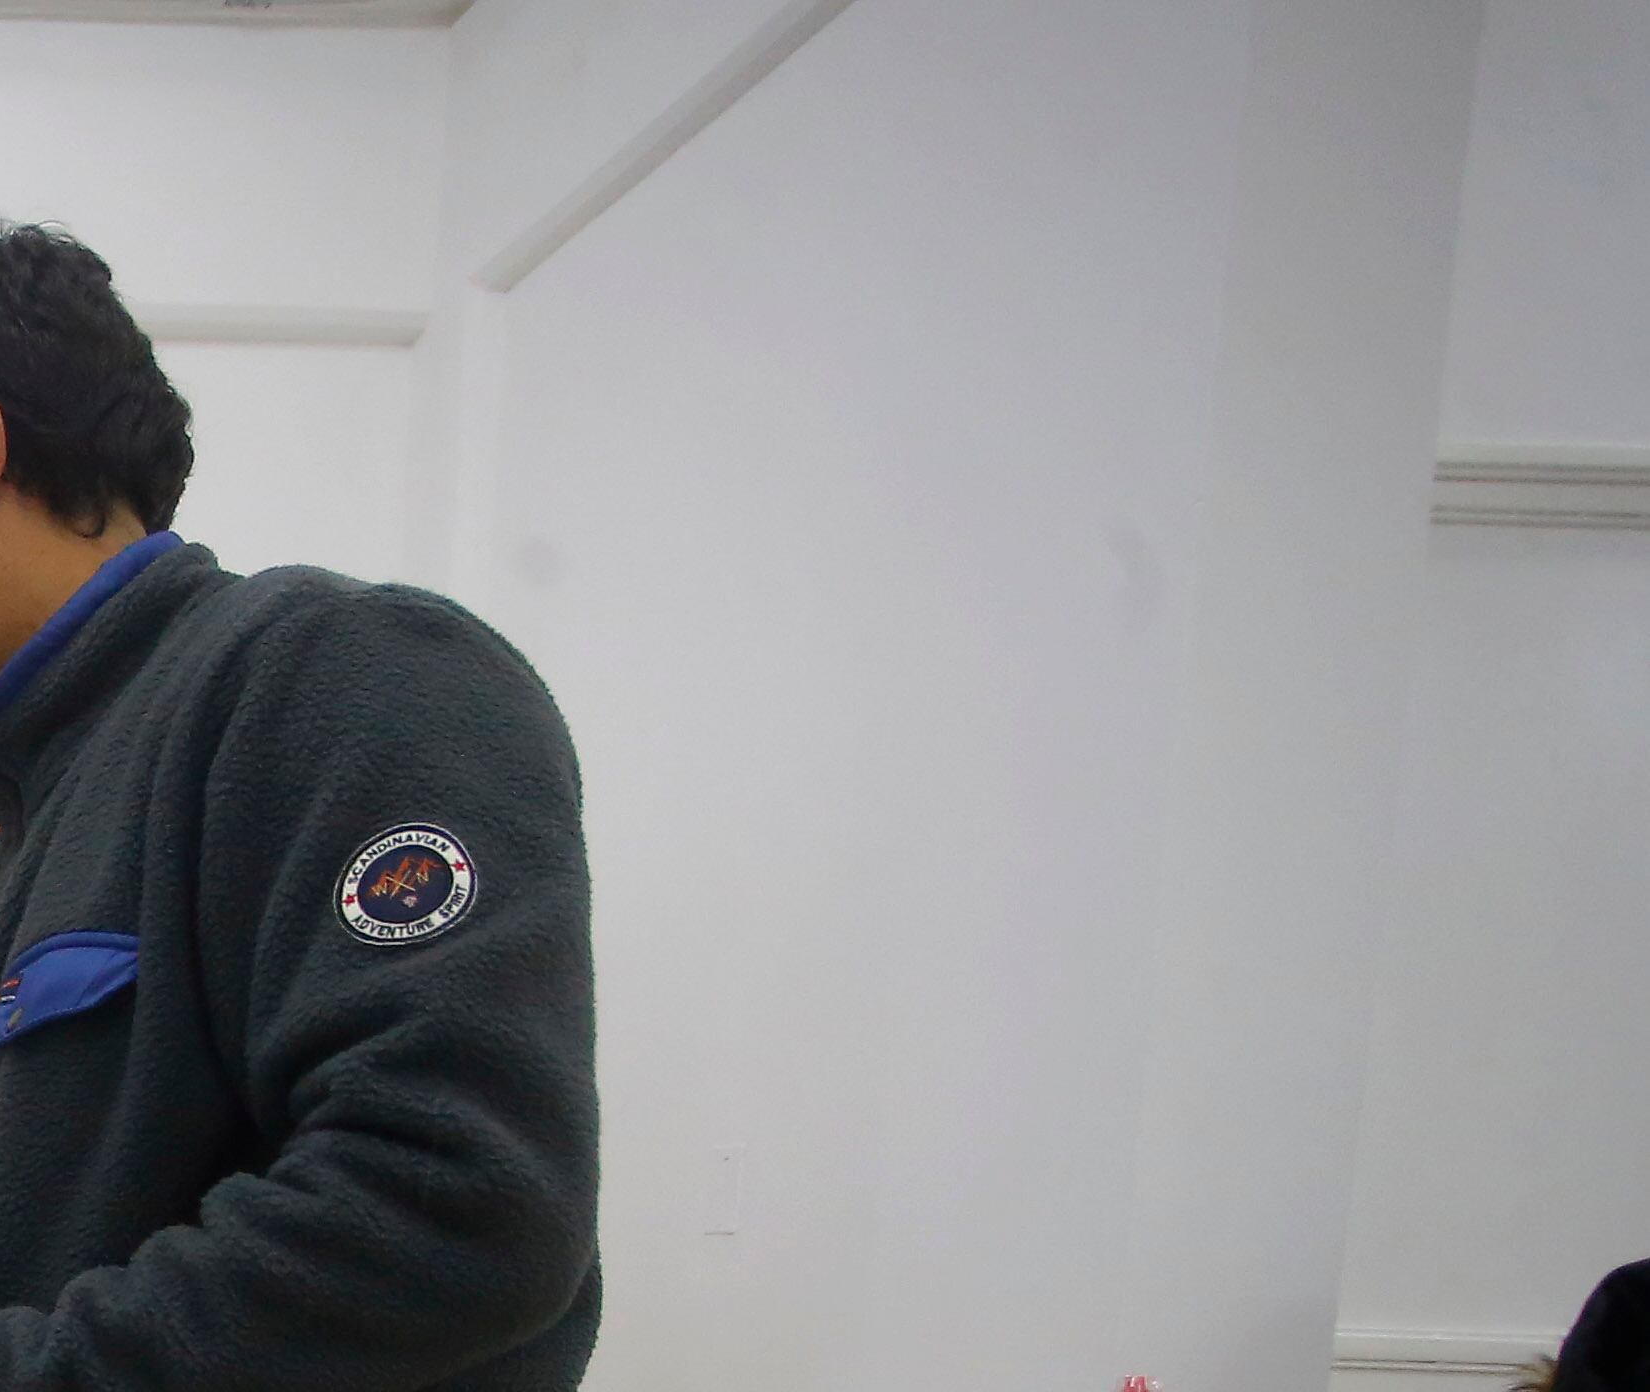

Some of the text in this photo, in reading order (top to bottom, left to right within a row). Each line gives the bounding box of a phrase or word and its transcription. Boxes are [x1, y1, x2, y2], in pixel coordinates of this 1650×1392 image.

[348, 832, 450, 885] SCANDINAVIAN
[352, 883, 468, 938] ADVENTURE SPIRIT
